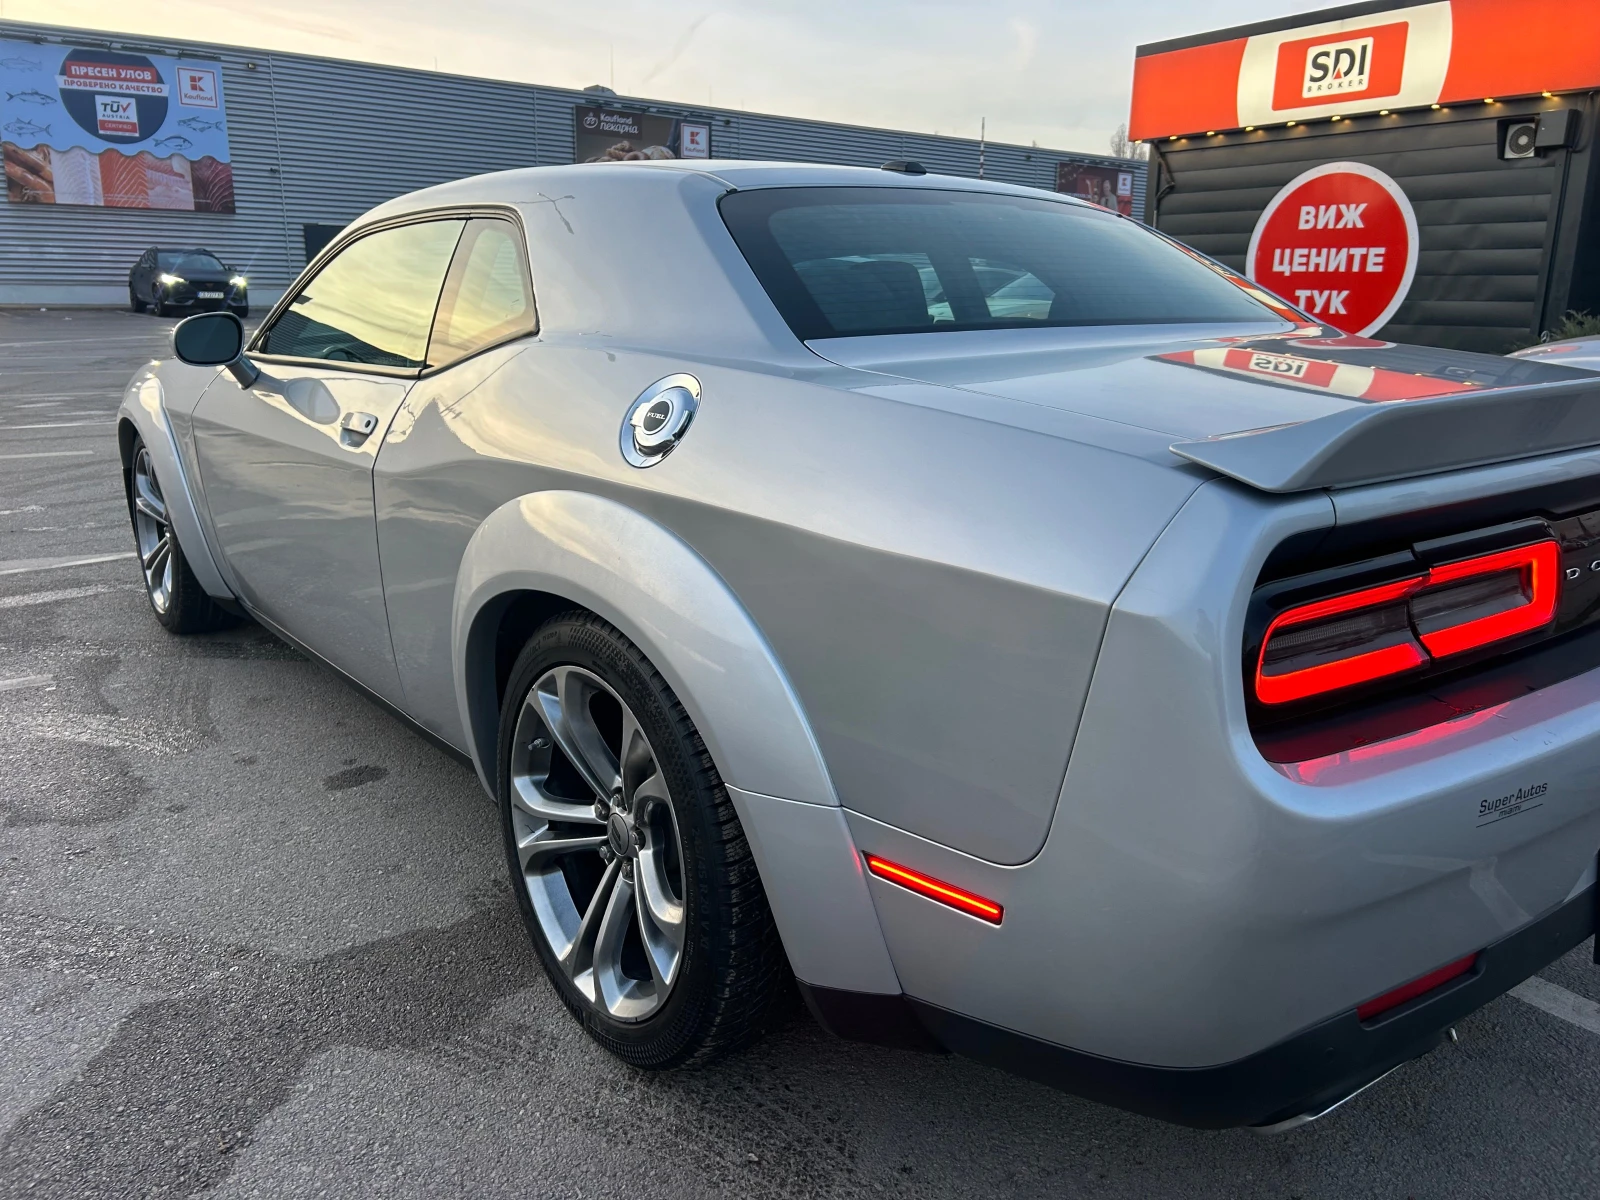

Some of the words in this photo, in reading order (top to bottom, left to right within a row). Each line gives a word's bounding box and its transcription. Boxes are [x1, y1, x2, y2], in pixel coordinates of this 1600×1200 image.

[1309, 44, 1368, 83] SDI
[70, 64, 117, 77] ПРЕСЕН
[120, 67, 152, 80] УЛОВ
[63, 79, 117, 89] ПРОВЕРЕНО
[118, 82, 163, 94] КАЧЕСТВО
[1307, 78, 1364, 93] BROKER
[183, 92, 214, 102] Kaufland
[600, 113, 633, 124] Kaufland
[1298, 203, 1368, 230] ВИЖ
[1272, 247, 1386, 276] ЦЕНИТЕ
[1295, 290, 1350, 314] ТУК
